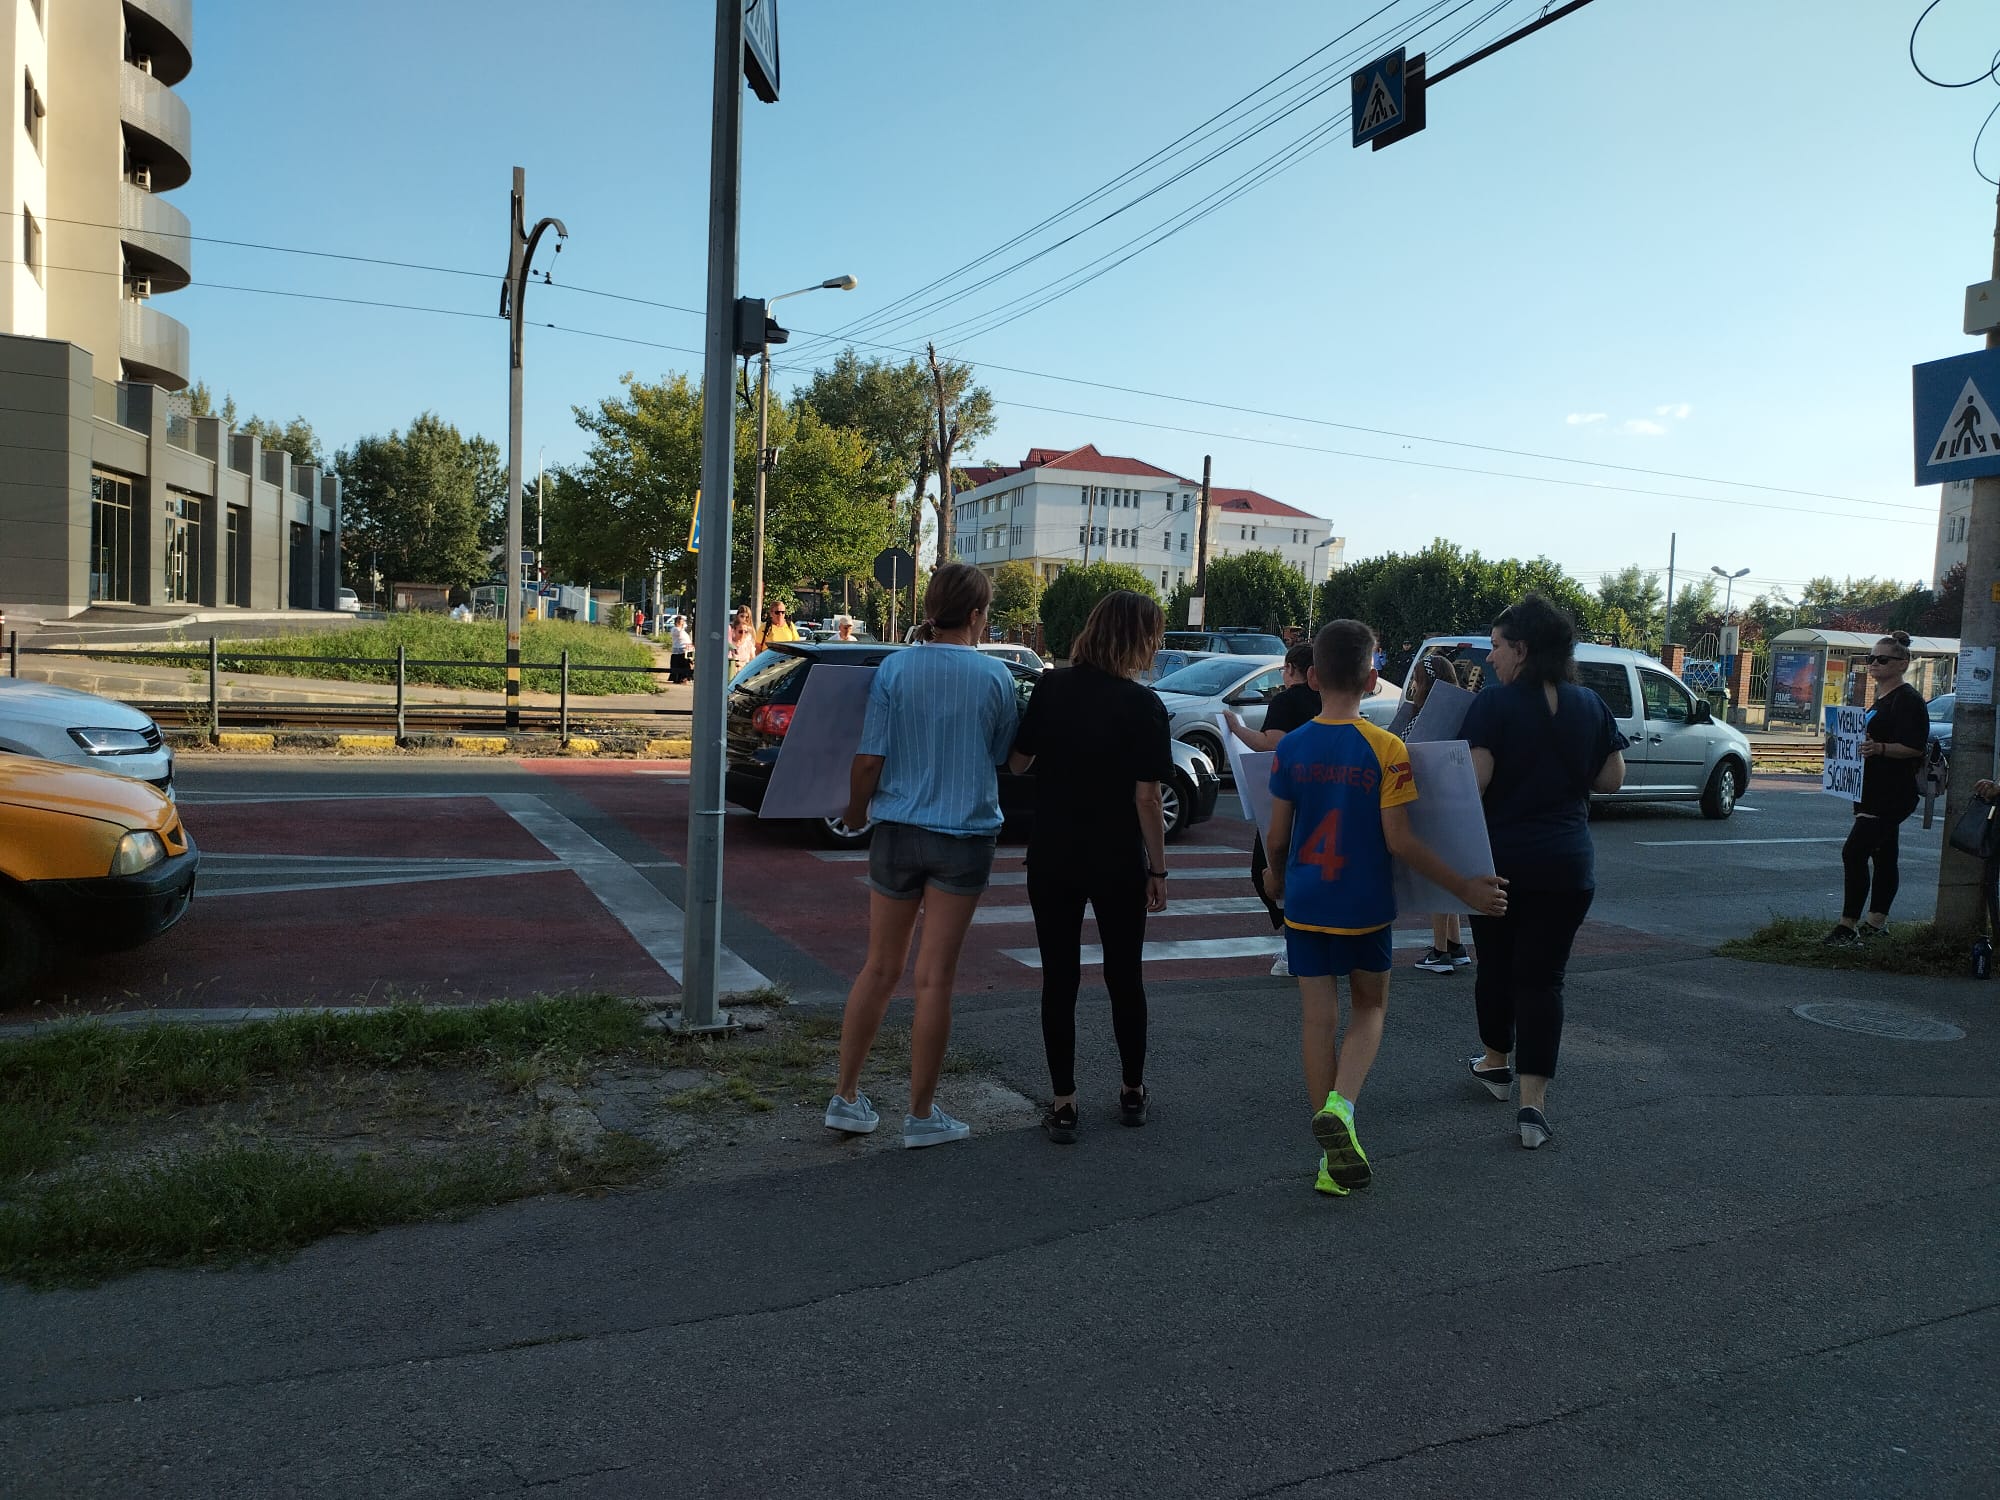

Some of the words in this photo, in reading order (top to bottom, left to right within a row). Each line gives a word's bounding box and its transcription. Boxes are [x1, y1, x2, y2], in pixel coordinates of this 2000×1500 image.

[1838, 711, 1858, 734] VREAU
[1838, 737, 1853, 760] TREC
[1299, 808, 1346, 880] 4
